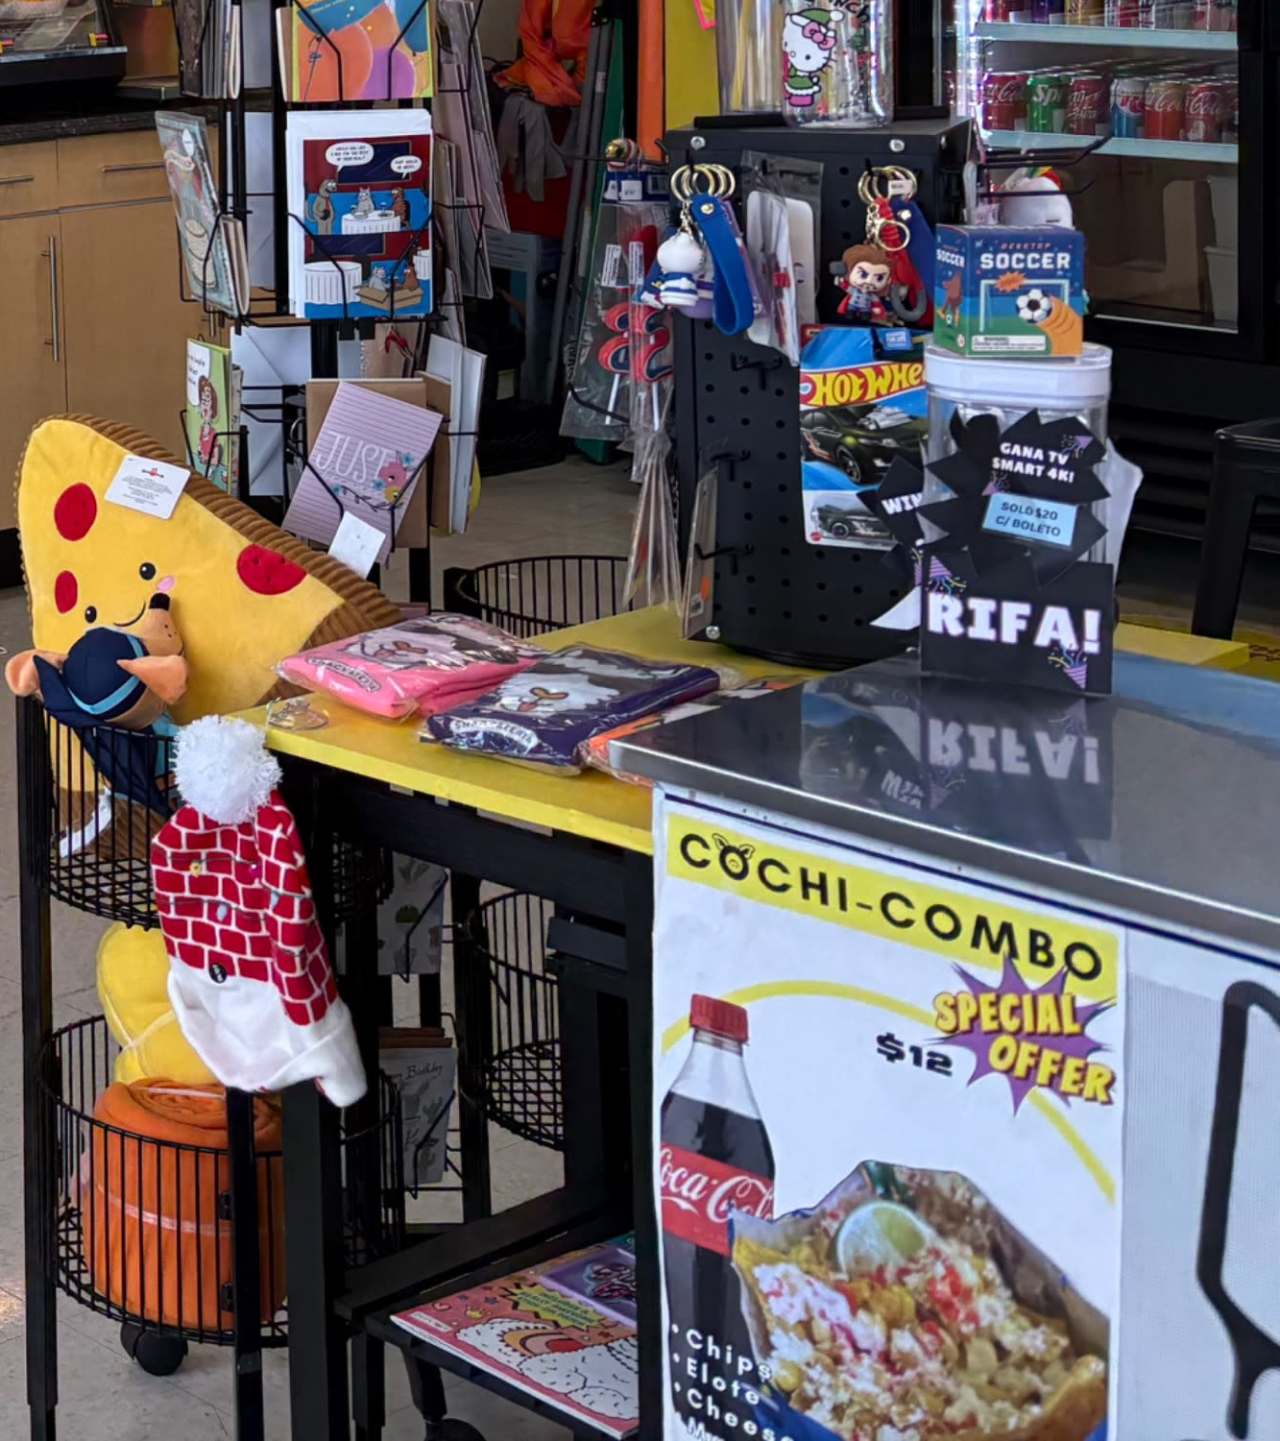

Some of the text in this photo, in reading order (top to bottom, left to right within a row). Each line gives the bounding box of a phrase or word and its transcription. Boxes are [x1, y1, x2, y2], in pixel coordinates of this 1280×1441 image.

[980, 252, 1071, 270] SOCCER
[315, 430, 396, 485] JUST
[992, 457, 1075, 483] SMART 4K!
[1000, 442, 1069, 465] GANA TV
[995, 515, 1062, 537] C/ BOLETO
[1000, 501, 1058, 521] SOLO $20
[927, 593, 1102, 654] RIFA!
[679, 833, 1104, 983] COCHI-COMBO
[933, 992, 1083, 1035] SPECIAL
[876, 1032, 954, 1076] $12
[988, 1037, 1118, 1105] OFFER
[686, 1329, 774, 1381] Chips
[687, 1358, 761, 1406] Elote
